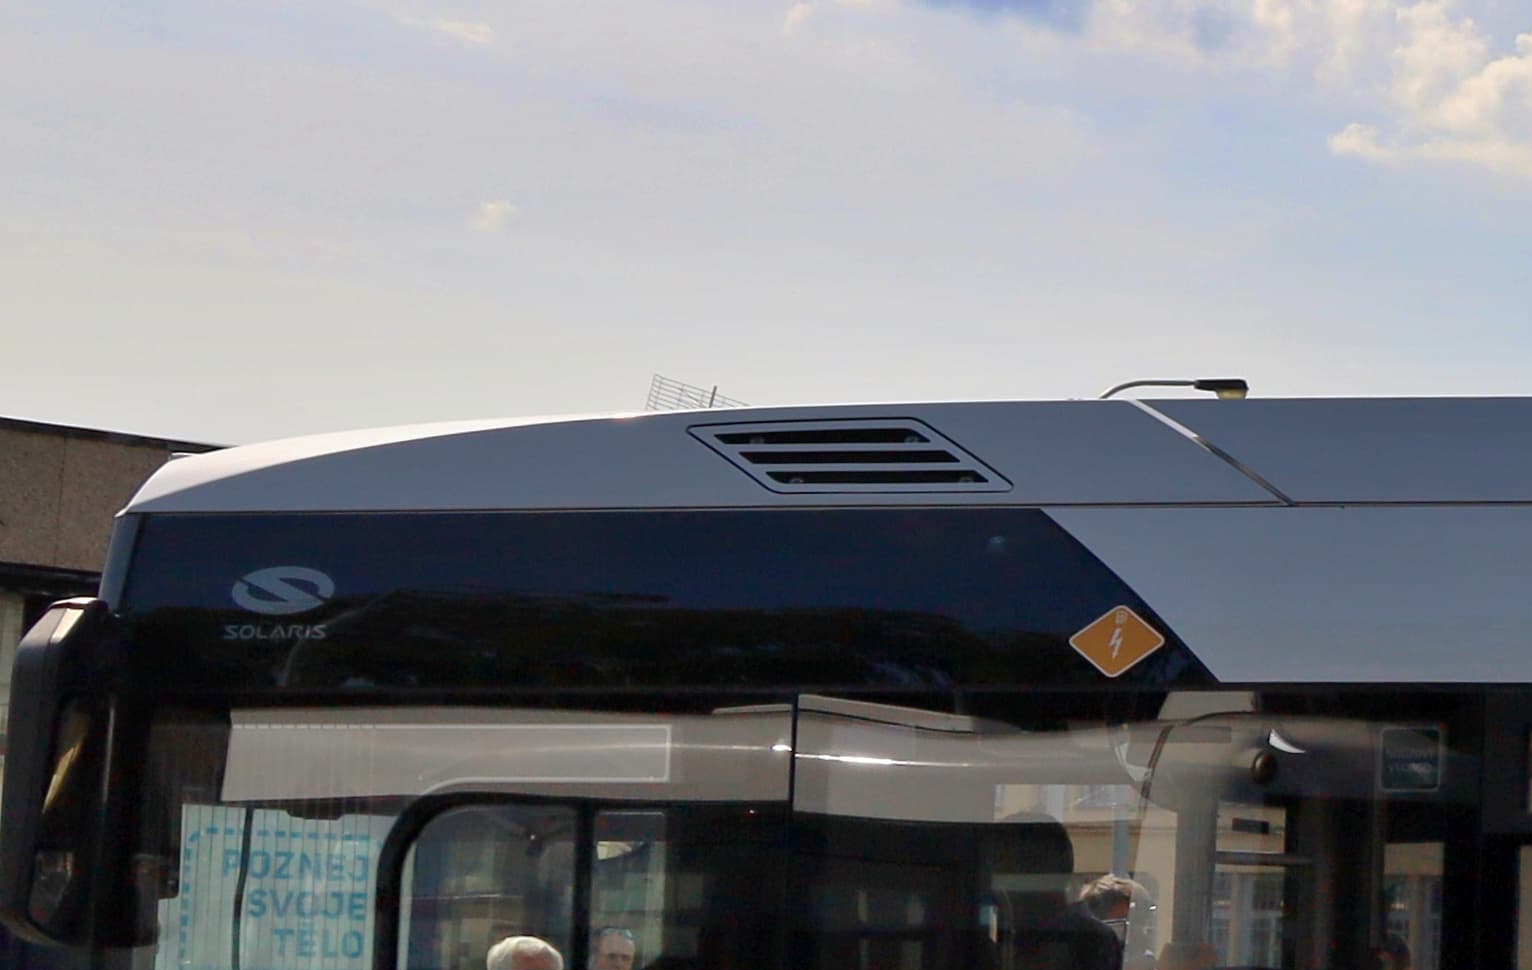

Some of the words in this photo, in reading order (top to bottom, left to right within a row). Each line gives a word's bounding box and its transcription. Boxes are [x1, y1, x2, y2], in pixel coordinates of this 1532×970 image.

[223, 624, 328, 640] SOLARIS
[222, 849, 369, 881] POZNEJ
[248, 889, 367, 921] SVOJE
[272, 921, 365, 958] TĚLO
